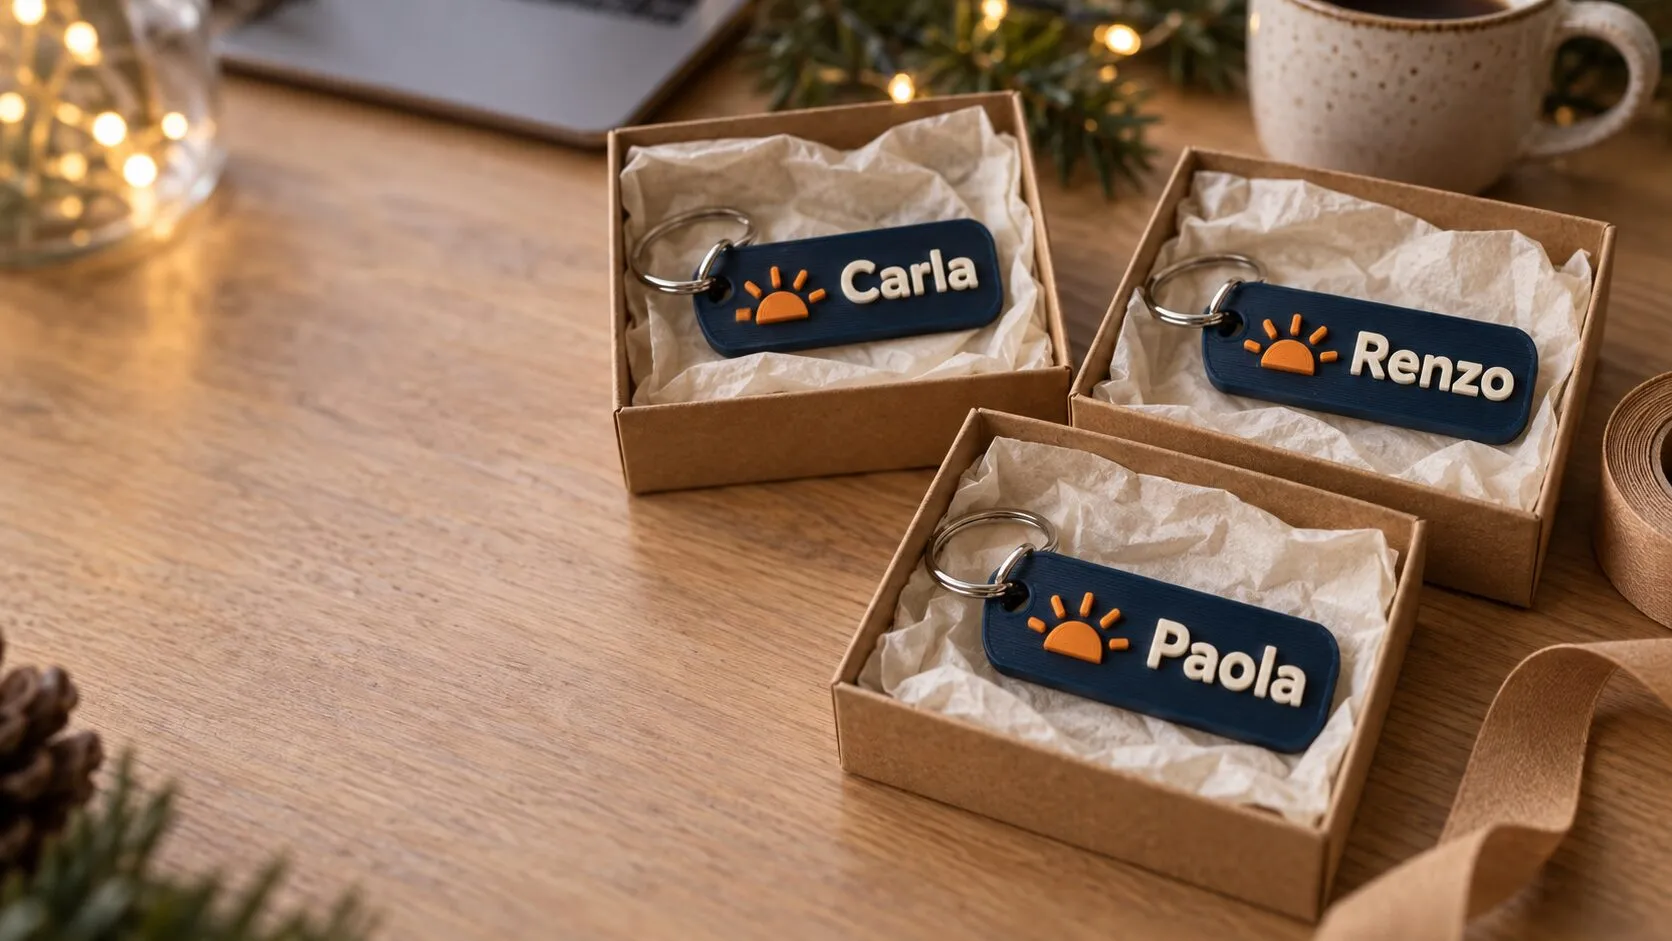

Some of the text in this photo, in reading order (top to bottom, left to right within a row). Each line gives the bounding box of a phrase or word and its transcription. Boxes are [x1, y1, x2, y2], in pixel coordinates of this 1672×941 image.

[840, 249, 979, 304] Carla
[1350, 330, 1515, 402] Renzo
[1147, 617, 1306, 708] Paola
